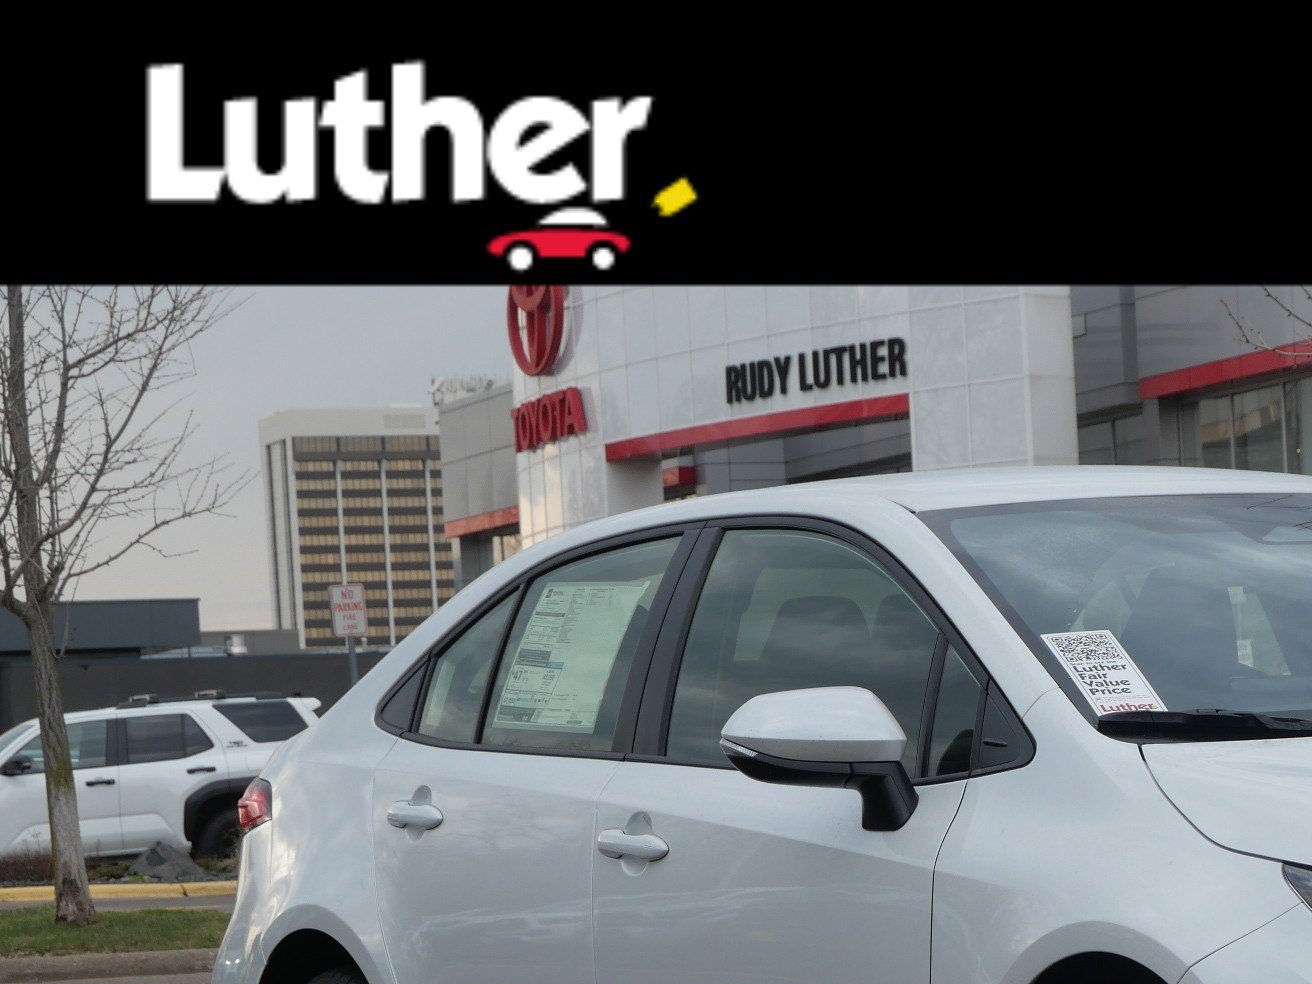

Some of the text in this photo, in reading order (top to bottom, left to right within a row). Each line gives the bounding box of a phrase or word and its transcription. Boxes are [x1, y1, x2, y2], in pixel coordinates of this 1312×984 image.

[725, 336, 908, 404] RUDY LUTHER
[511, 386, 588, 453] TOYOTA
[1072, 663, 1127, 673] Luther
[1078, 671, 1108, 681] Fair
[1082, 679, 1131, 688] Value
[1088, 686, 1132, 696] Price
[1100, 702, 1154, 713] Luther
